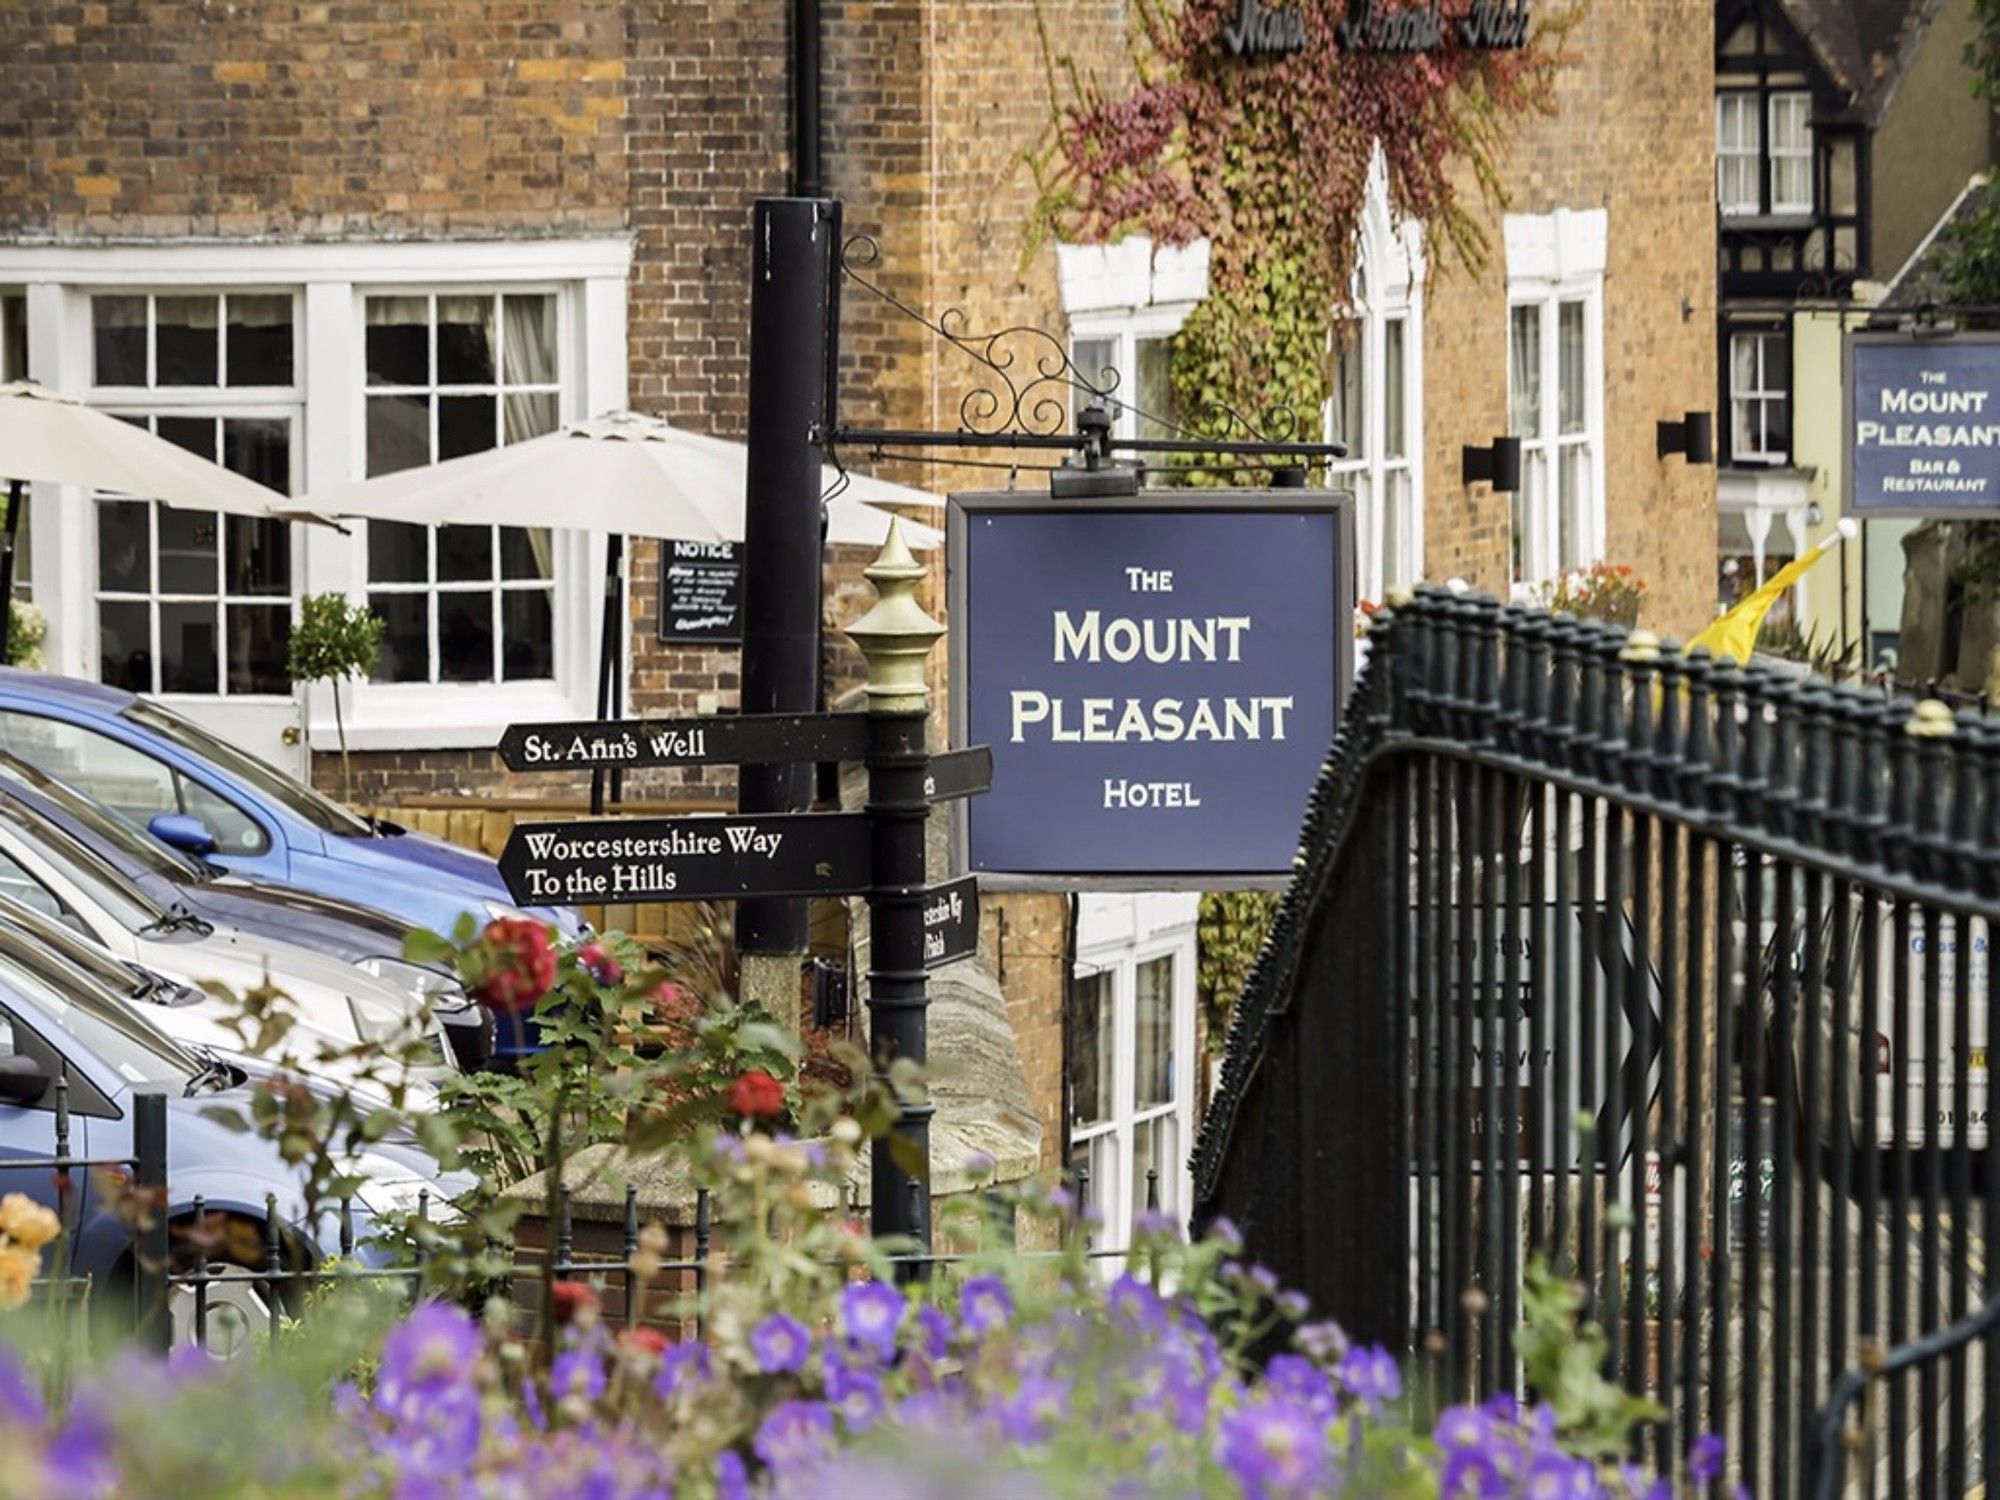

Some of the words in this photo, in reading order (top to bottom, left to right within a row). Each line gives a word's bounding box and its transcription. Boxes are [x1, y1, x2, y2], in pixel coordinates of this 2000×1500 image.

[1920, 371, 1946, 384] THE
[1880, 387, 1988, 414] MOUNT
[1910, 459, 1944, 474] BAR
[1946, 459, 1961, 475] &
[1882, 476, 1987, 492] RESTAURANT
[674, 541, 733, 559] NOTICE
[1125, 566, 1173, 591] THE
[1053, 610, 1250, 663] MOUNT
[1010, 690, 1294, 743] PLEASANT
[524, 734, 560, 763] St.
[566, 732, 638, 761] Ann's
[649, 728, 706, 758] Well
[1103, 779, 1200, 808] HOTEL
[525, 830, 722, 861] Worcestershire
[724, 826, 783, 859] Way
[525, 868, 561, 897] To
[566, 863, 607, 893] the
[612, 863, 678, 893] Hills
